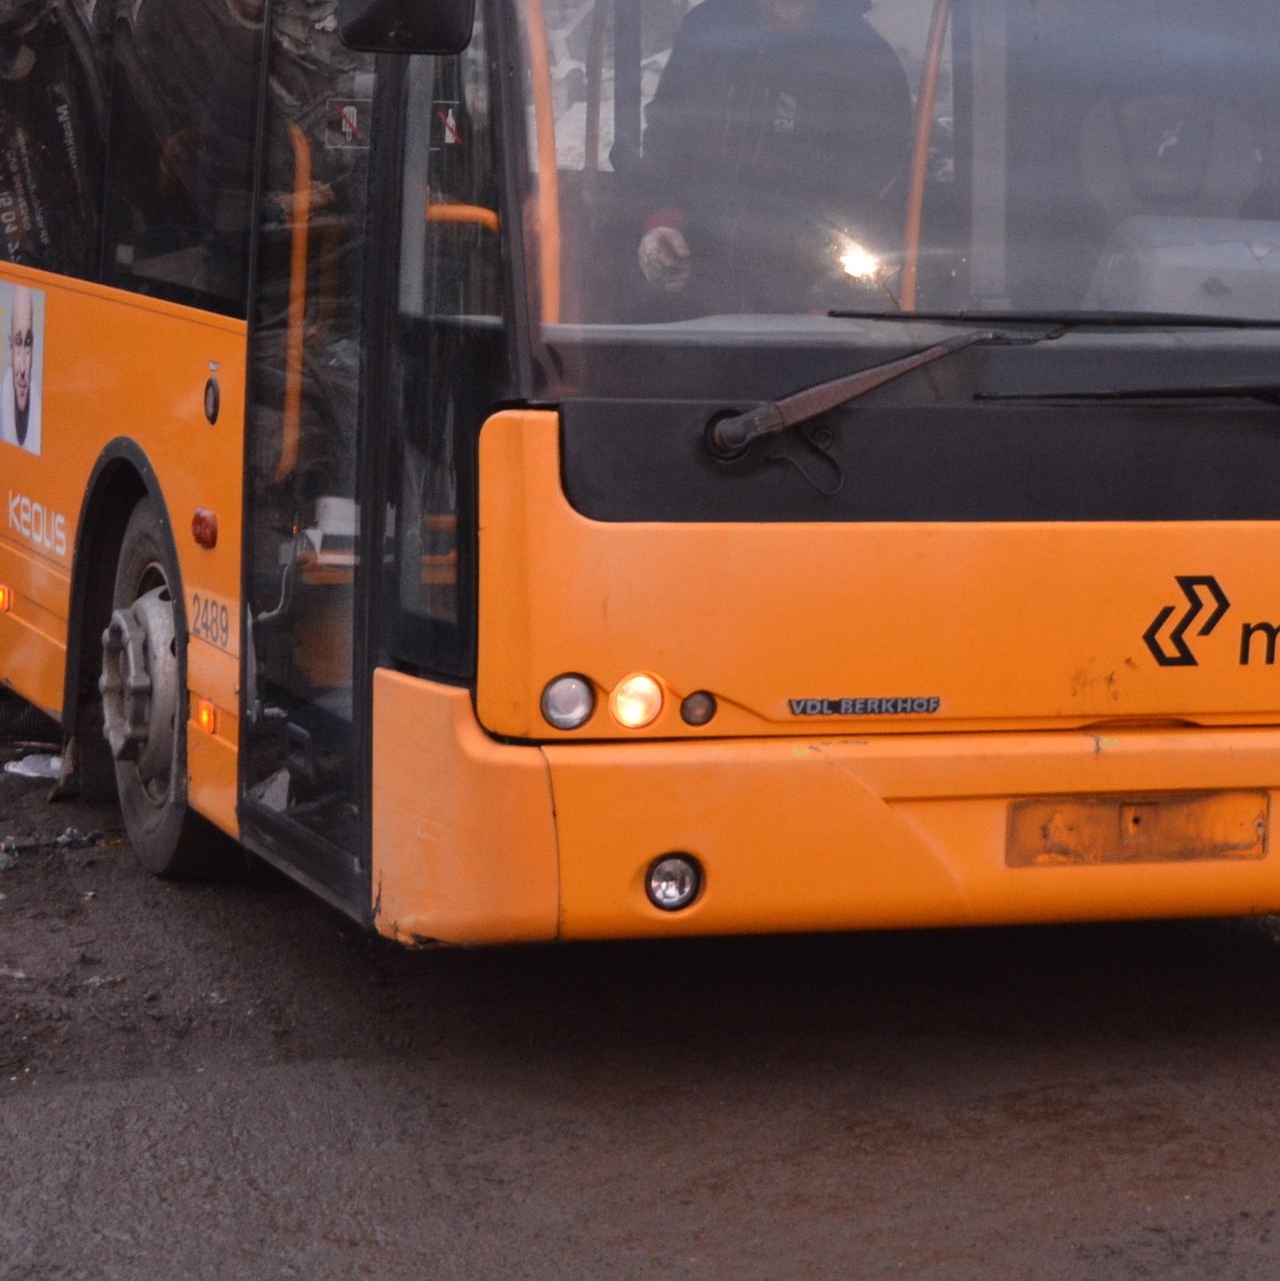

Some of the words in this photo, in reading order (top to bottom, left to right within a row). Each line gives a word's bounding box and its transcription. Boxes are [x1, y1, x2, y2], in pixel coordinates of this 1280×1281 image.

[192, 593, 229, 648] 2489
[789, 699, 833, 715] VDL
[839, 697, 941, 714] BERKHOF
